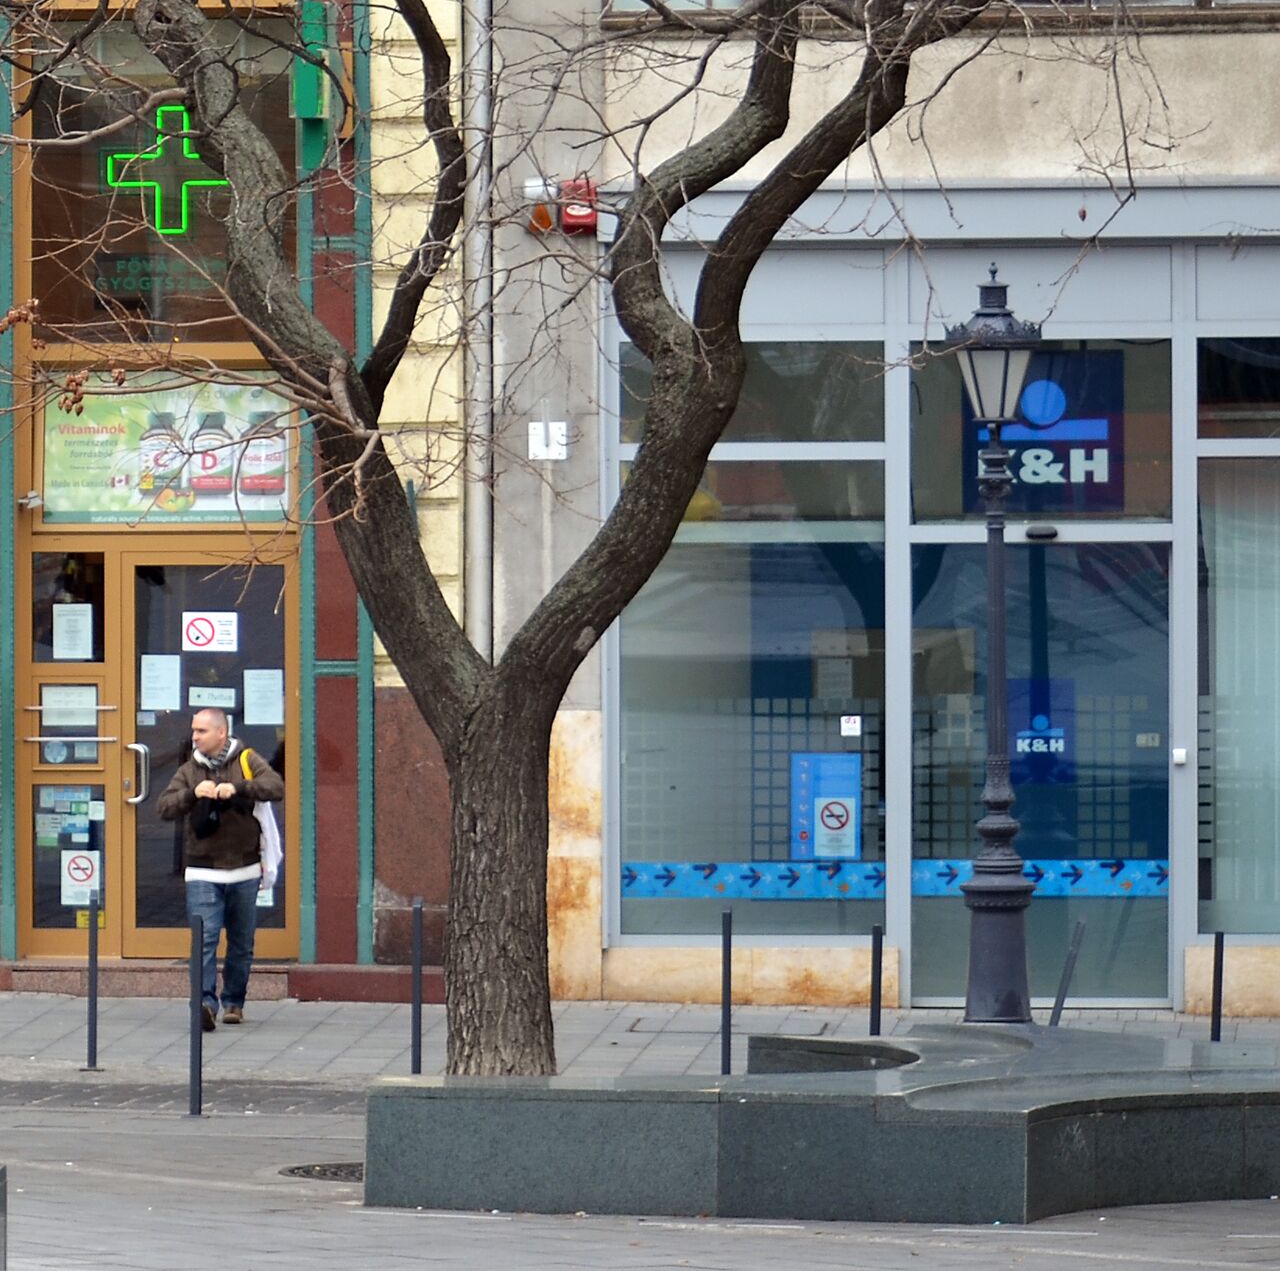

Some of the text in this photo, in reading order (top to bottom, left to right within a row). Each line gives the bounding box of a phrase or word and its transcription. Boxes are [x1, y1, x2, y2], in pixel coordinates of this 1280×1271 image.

[57, 423, 126, 435] Vitaminok
[200, 451, 218, 470] D
[1016, 738, 1065, 752] K&H
